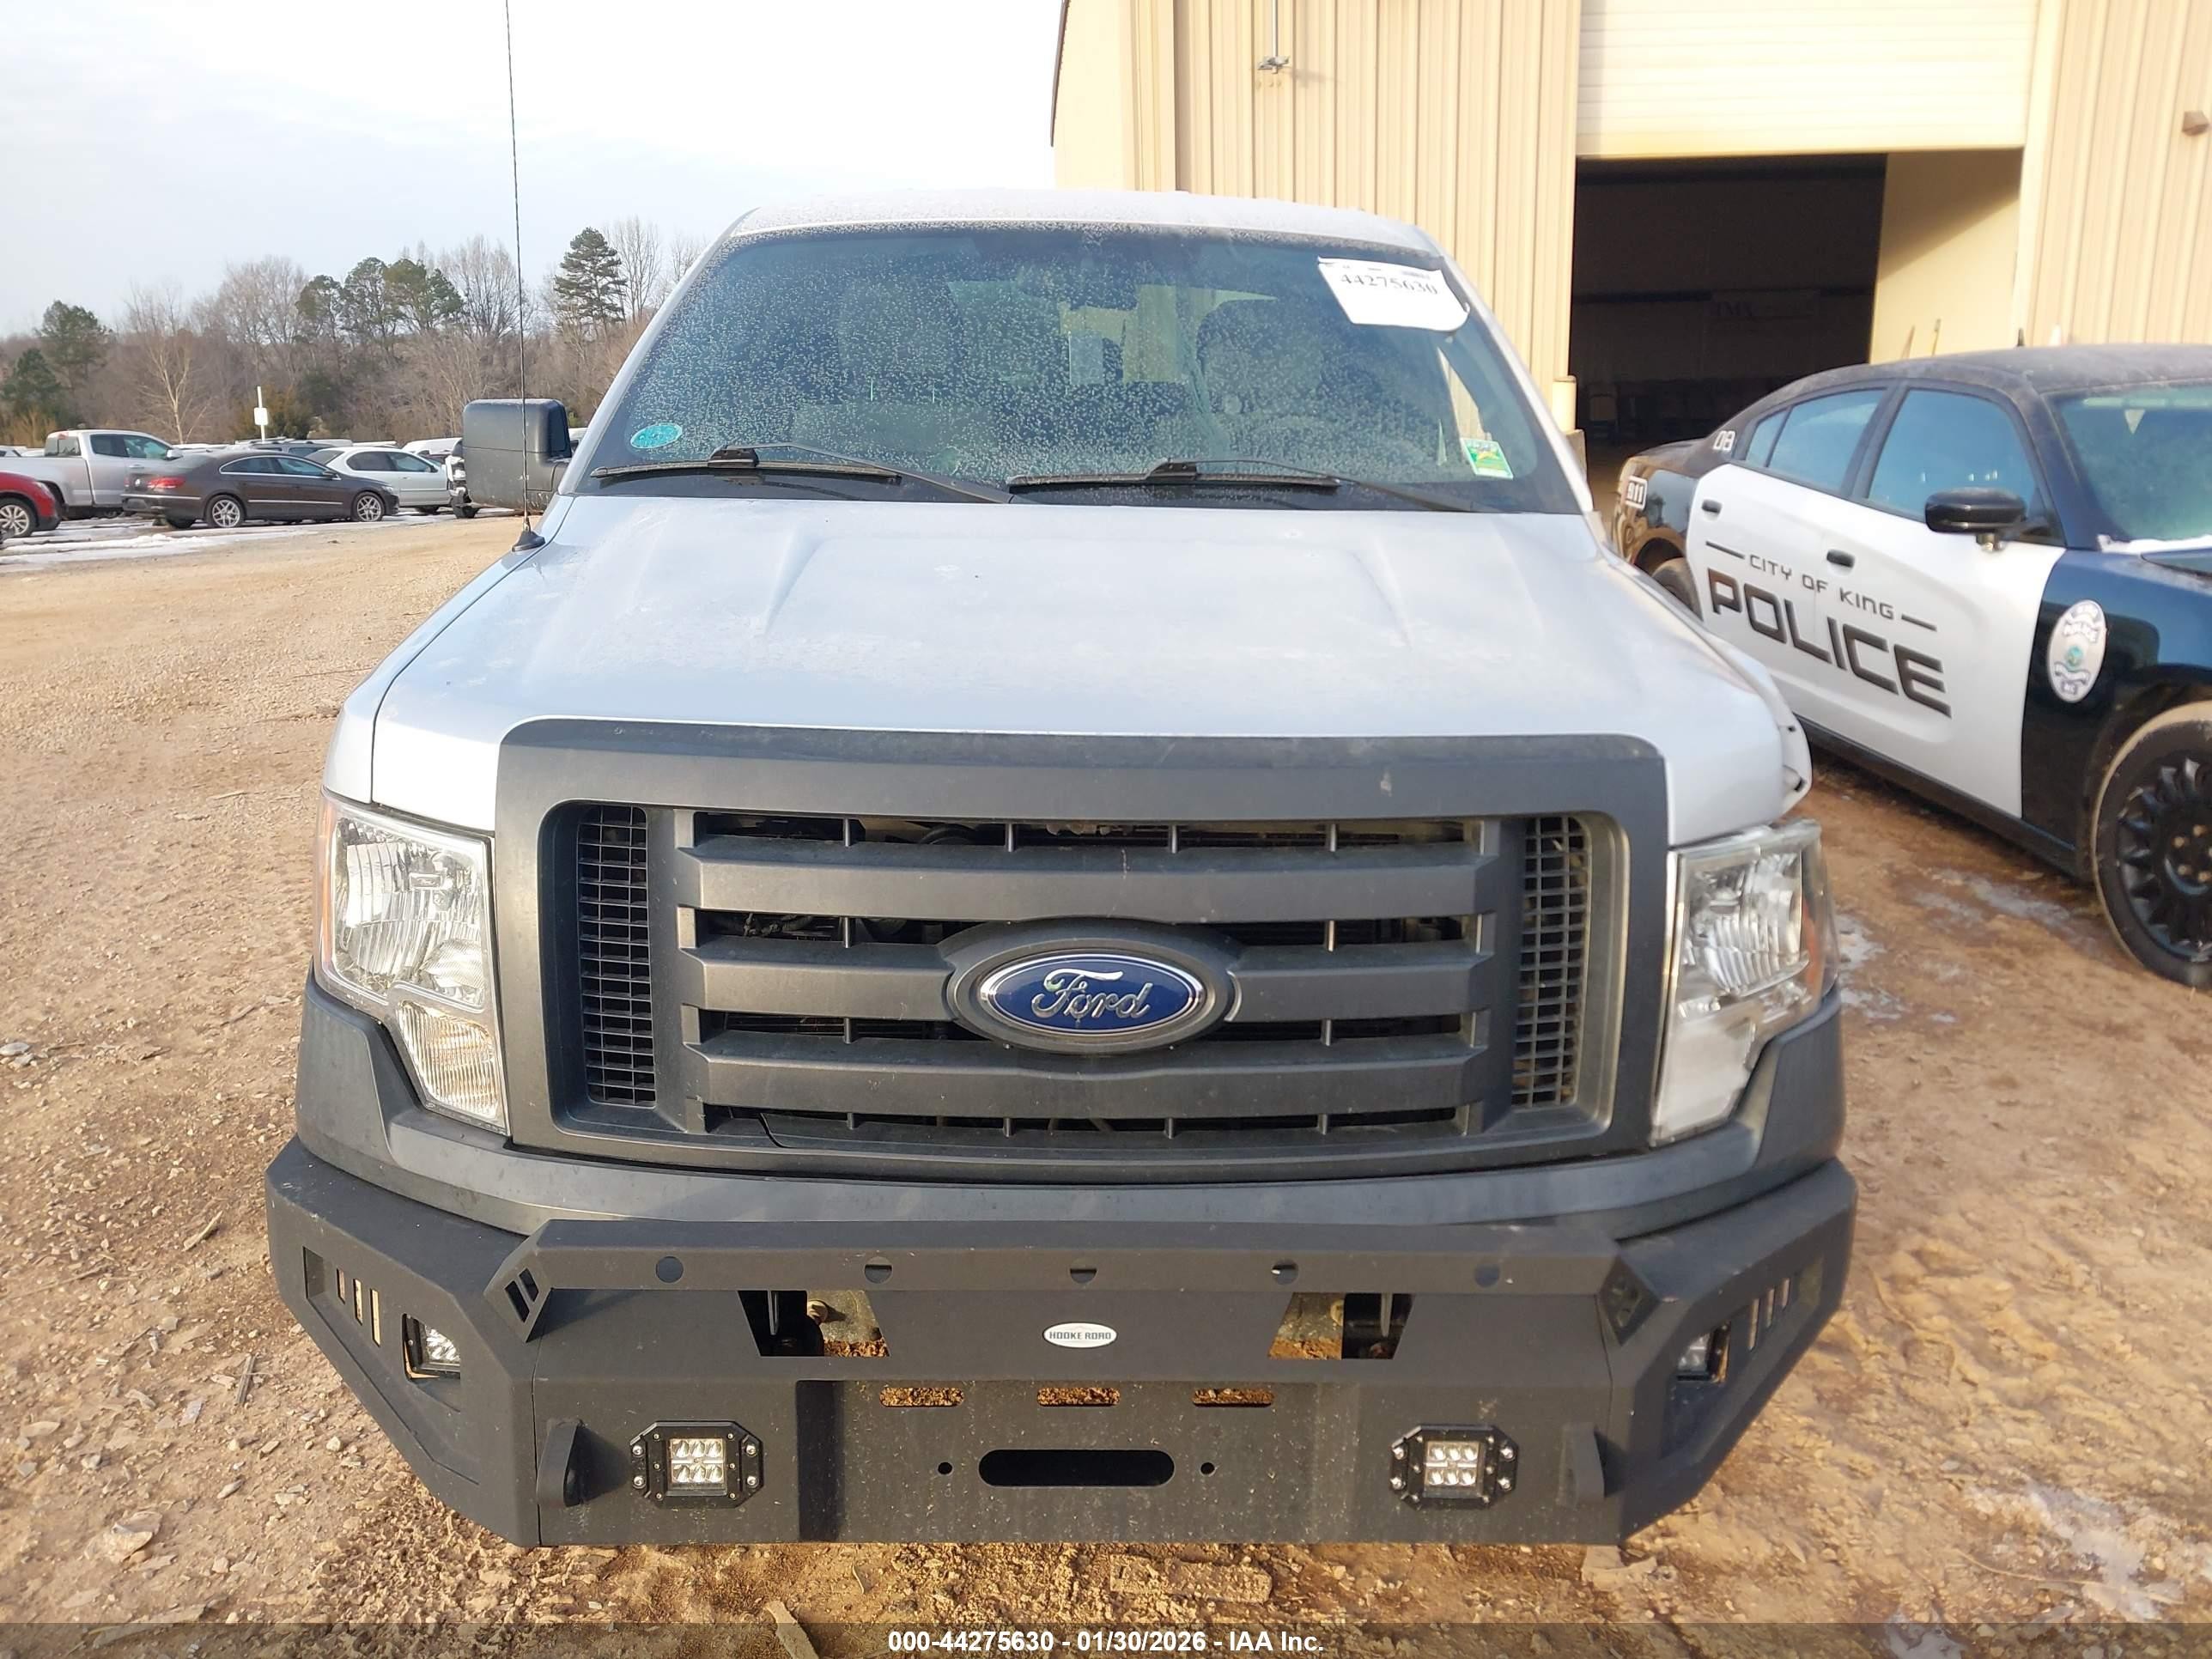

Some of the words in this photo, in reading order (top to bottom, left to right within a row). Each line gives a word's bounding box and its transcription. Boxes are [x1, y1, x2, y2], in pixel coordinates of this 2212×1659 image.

[1713, 430, 1735, 451] 08
[1749, 554, 1792, 580] CITY
[1802, 574, 1829, 593] OF
[1839, 586, 1894, 620] KING
[1707, 567, 1952, 719] POLICE
[1031, 967, 1153, 1019] Ford
[1048, 1331, 1083, 1340] HOOKE
[1085, 1332, 1112, 1340] ROAD
